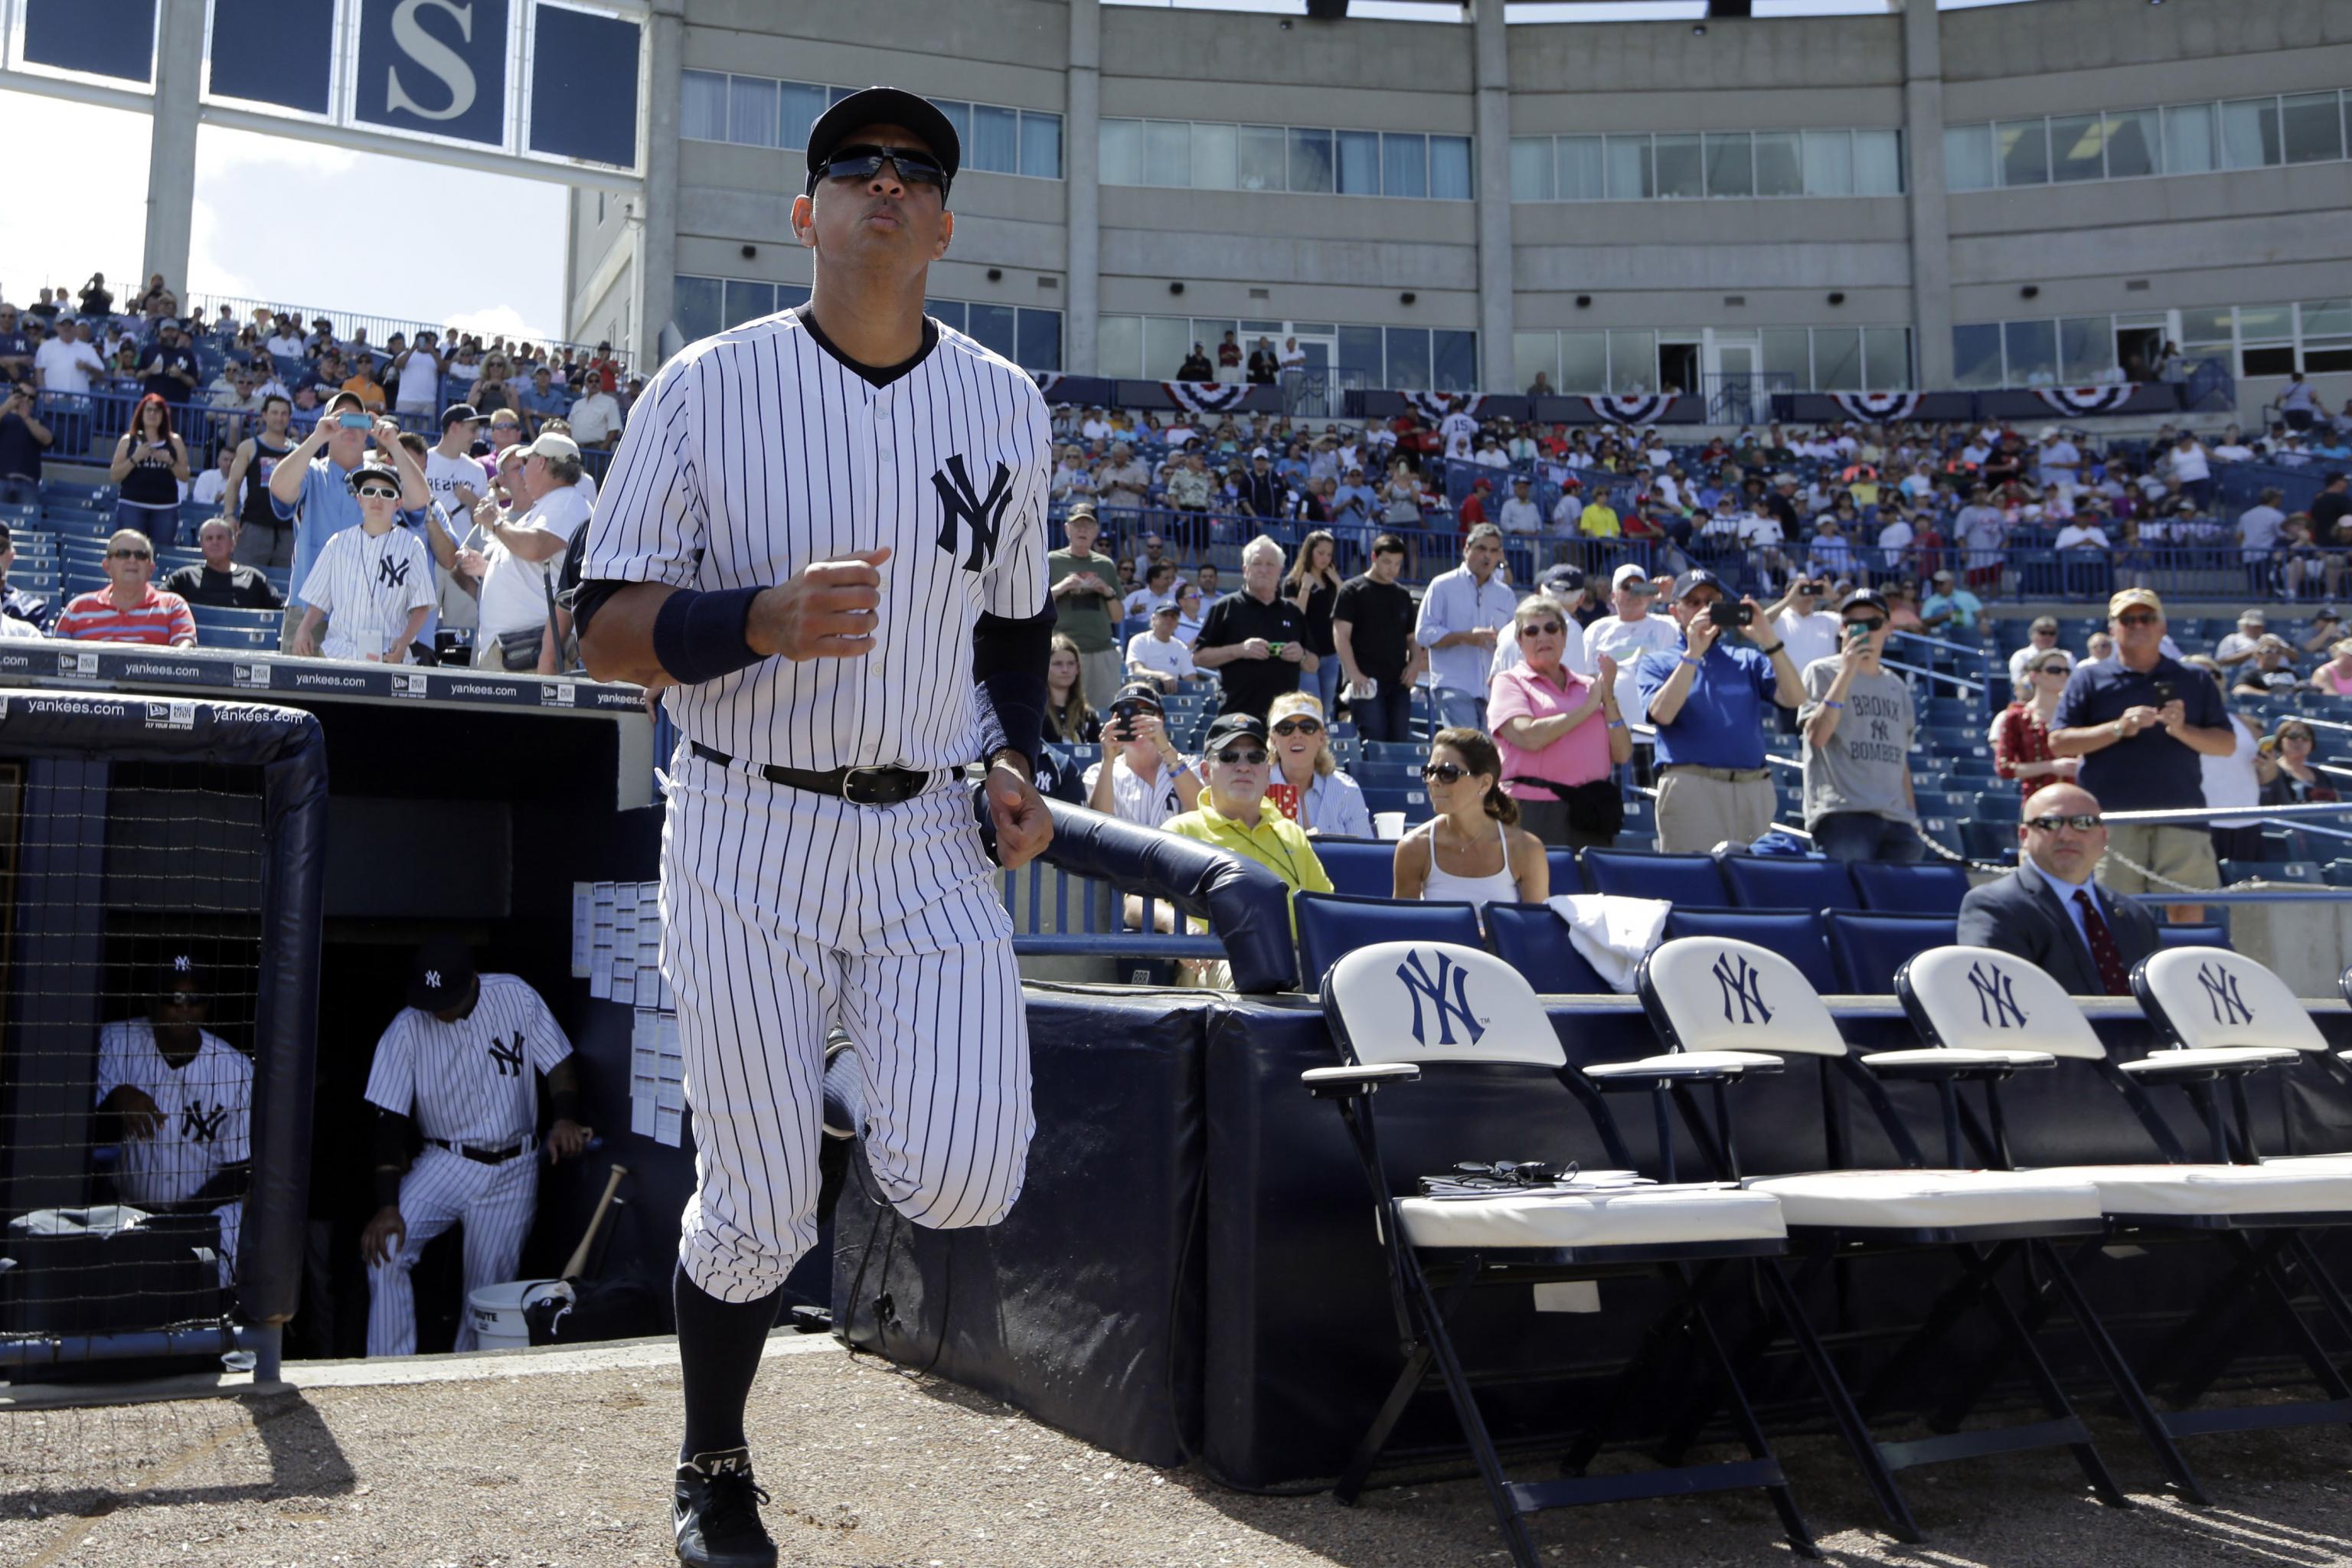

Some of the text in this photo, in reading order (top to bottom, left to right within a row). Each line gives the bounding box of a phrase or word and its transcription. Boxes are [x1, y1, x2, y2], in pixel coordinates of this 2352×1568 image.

[387, 0, 477, 120] S
[1454, 420, 1468, 432] 15
[929, 453, 1013, 573] NY
[379, 554, 410, 588] NY
[126, 662, 199, 677] yankees.com
[296, 673, 365, 688] yankees.com
[451, 683, 517, 697] yankees.com
[28, 699, 125, 717] yankees.com
[214, 709, 302, 724] yankees.com
[1851, 694, 1900, 722] BRONX
[1034, 770, 1053, 792] NY
[426, 969, 442, 988] NY
[1712, 951, 1772, 1026] NY
[2197, 961, 2253, 1026] NY
[1396, 948, 1485, 1048] NY
[1968, 959, 2027, 1030] NY
[488, 1031, 526, 1078] NY
[181, 1099, 228, 1142] NY
